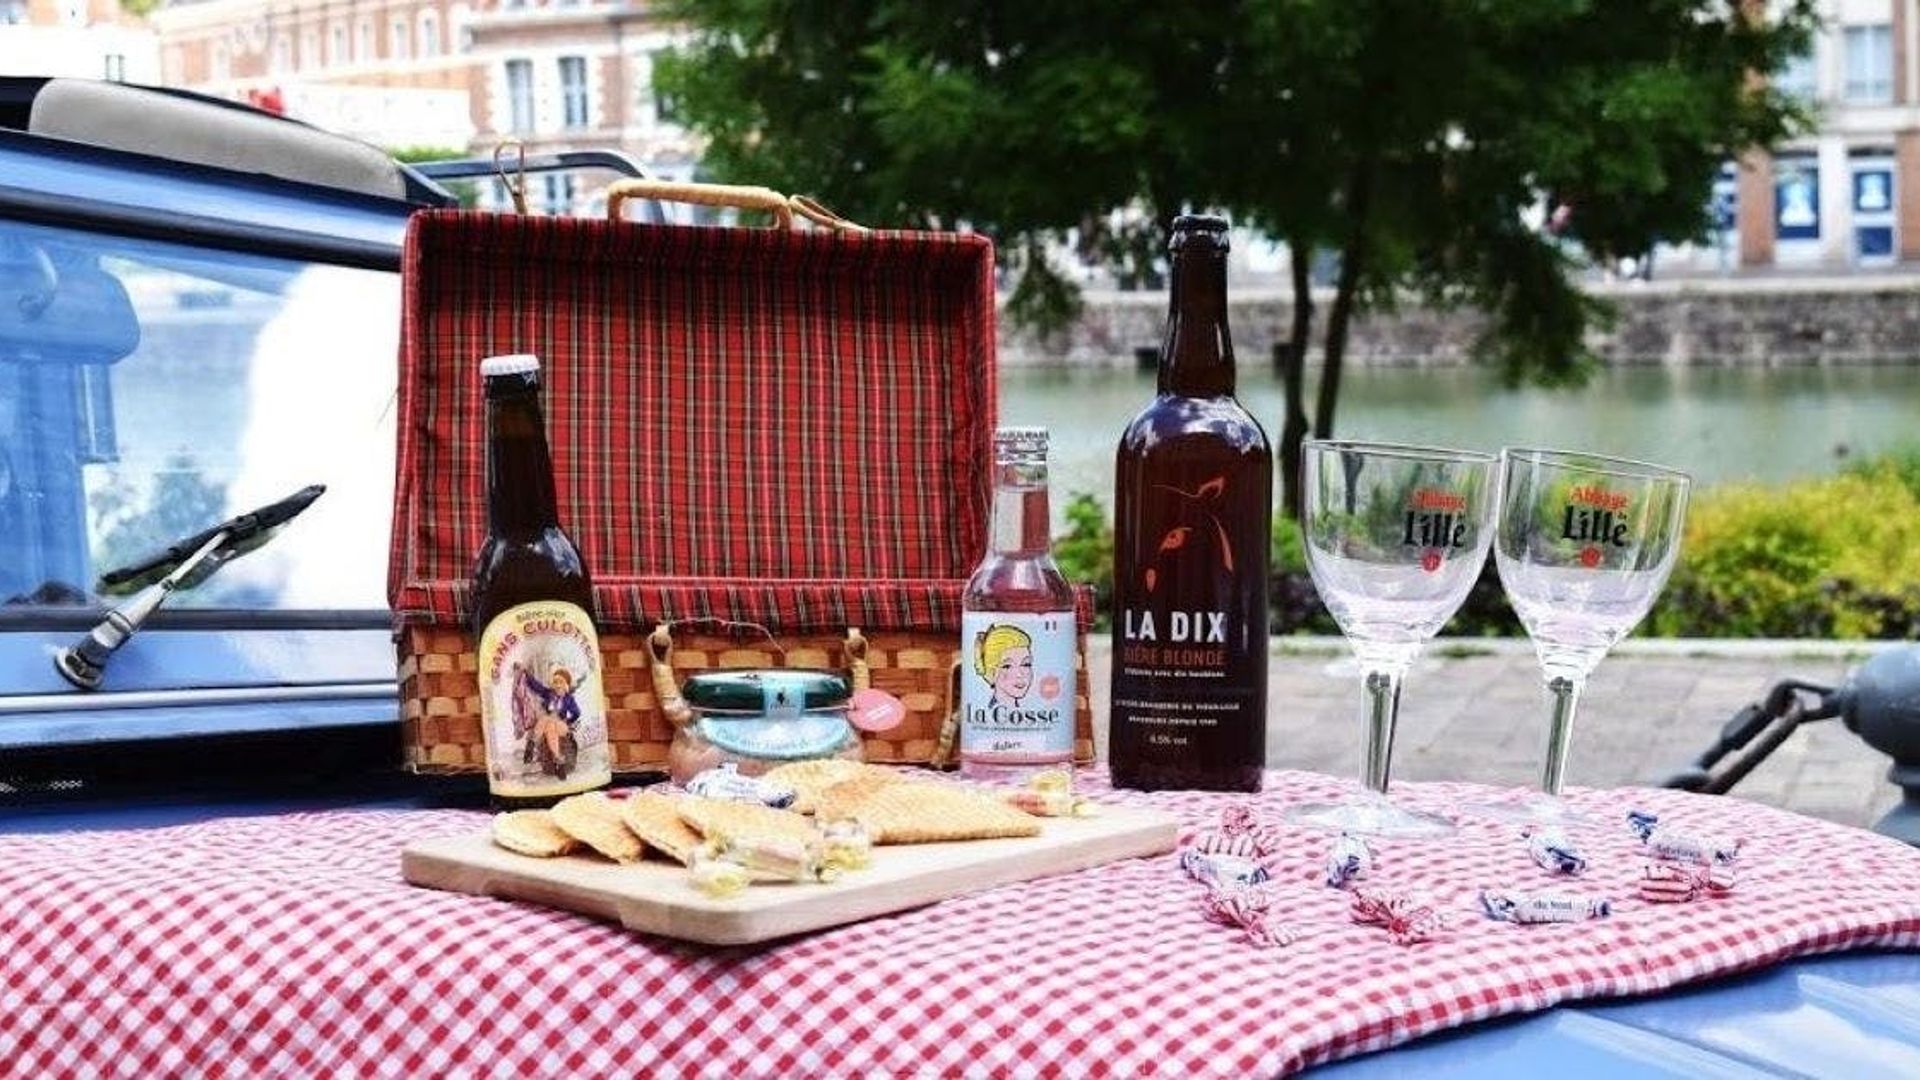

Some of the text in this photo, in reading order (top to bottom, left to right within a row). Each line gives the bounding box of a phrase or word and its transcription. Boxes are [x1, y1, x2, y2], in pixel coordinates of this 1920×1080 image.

[1404, 511, 1466, 547] Lille
[1561, 506, 1628, 547] Lille
[1125, 609, 1226, 643] LA DIX
[1163, 650, 1226, 666] BLONDE
